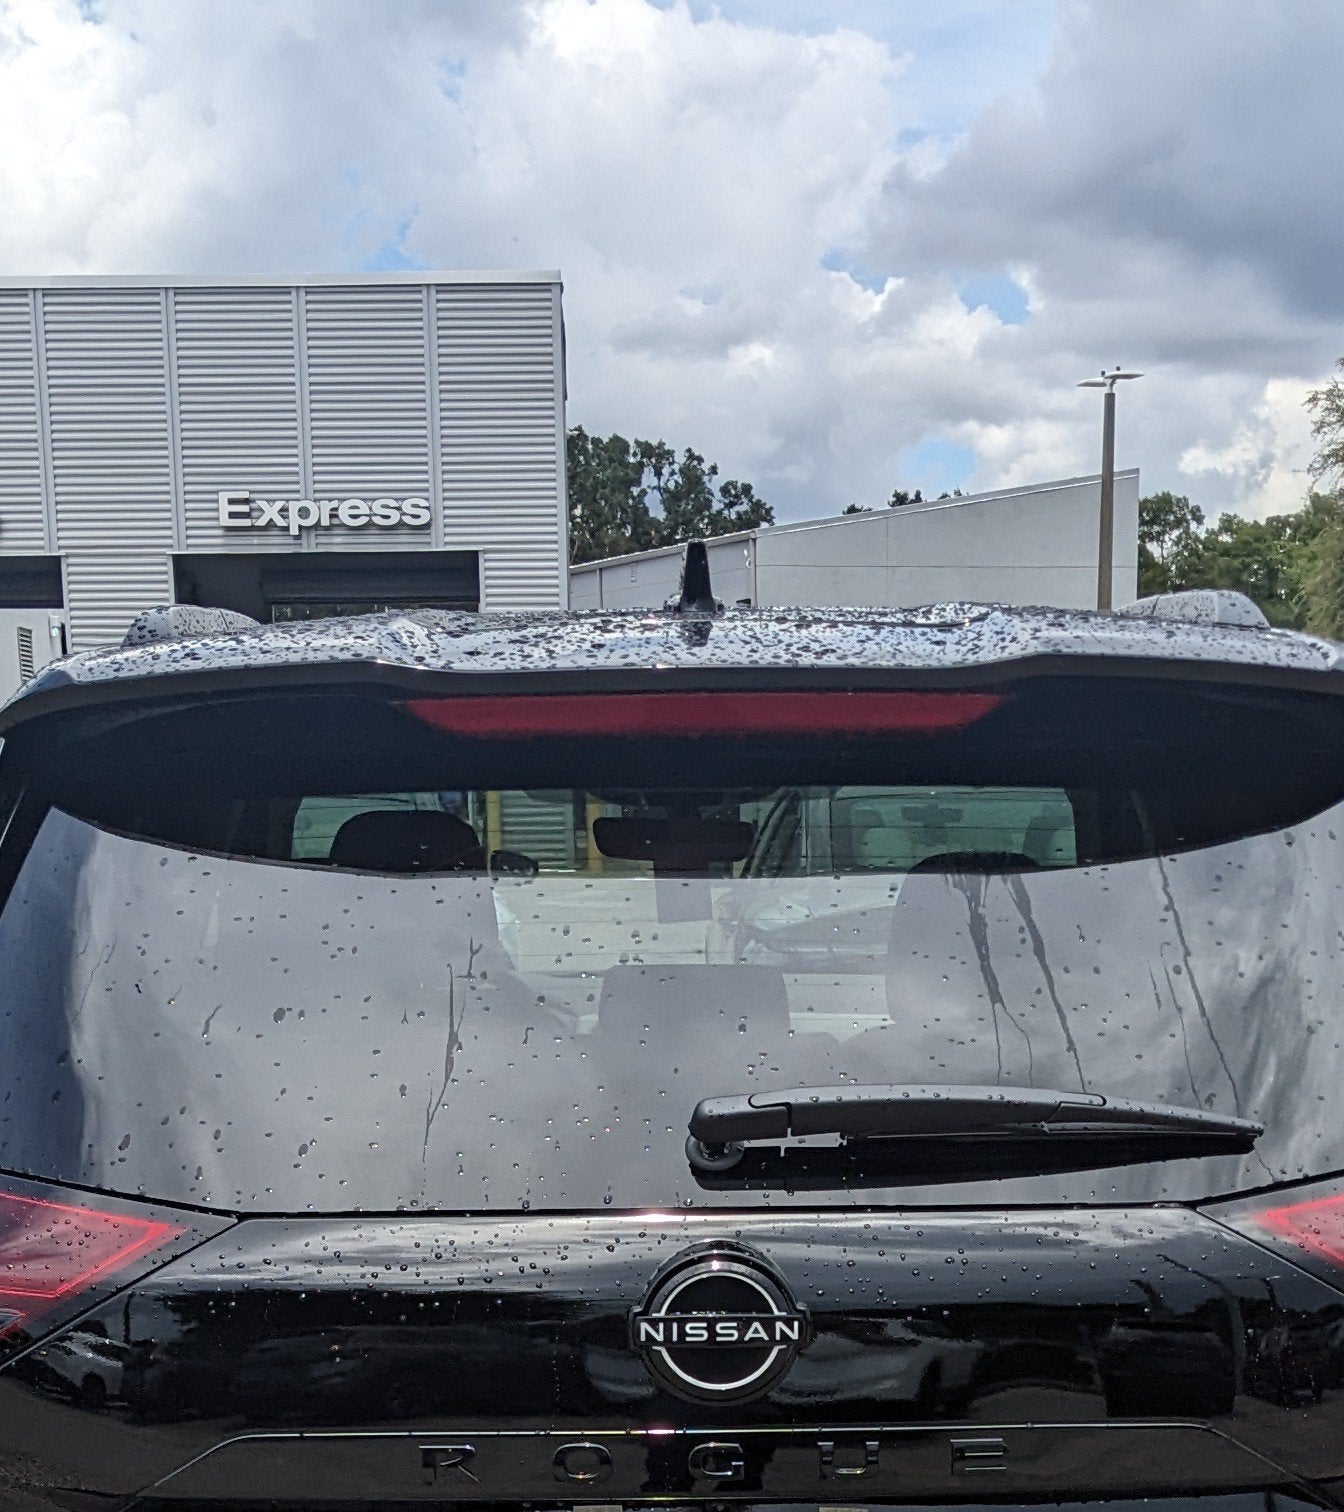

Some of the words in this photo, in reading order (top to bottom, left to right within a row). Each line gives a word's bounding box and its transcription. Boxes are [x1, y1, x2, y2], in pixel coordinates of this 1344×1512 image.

[218, 490, 431, 536] Express
[639, 1320, 800, 1342] NISSAN
[419, 1437, 1008, 1486] ROGUE
